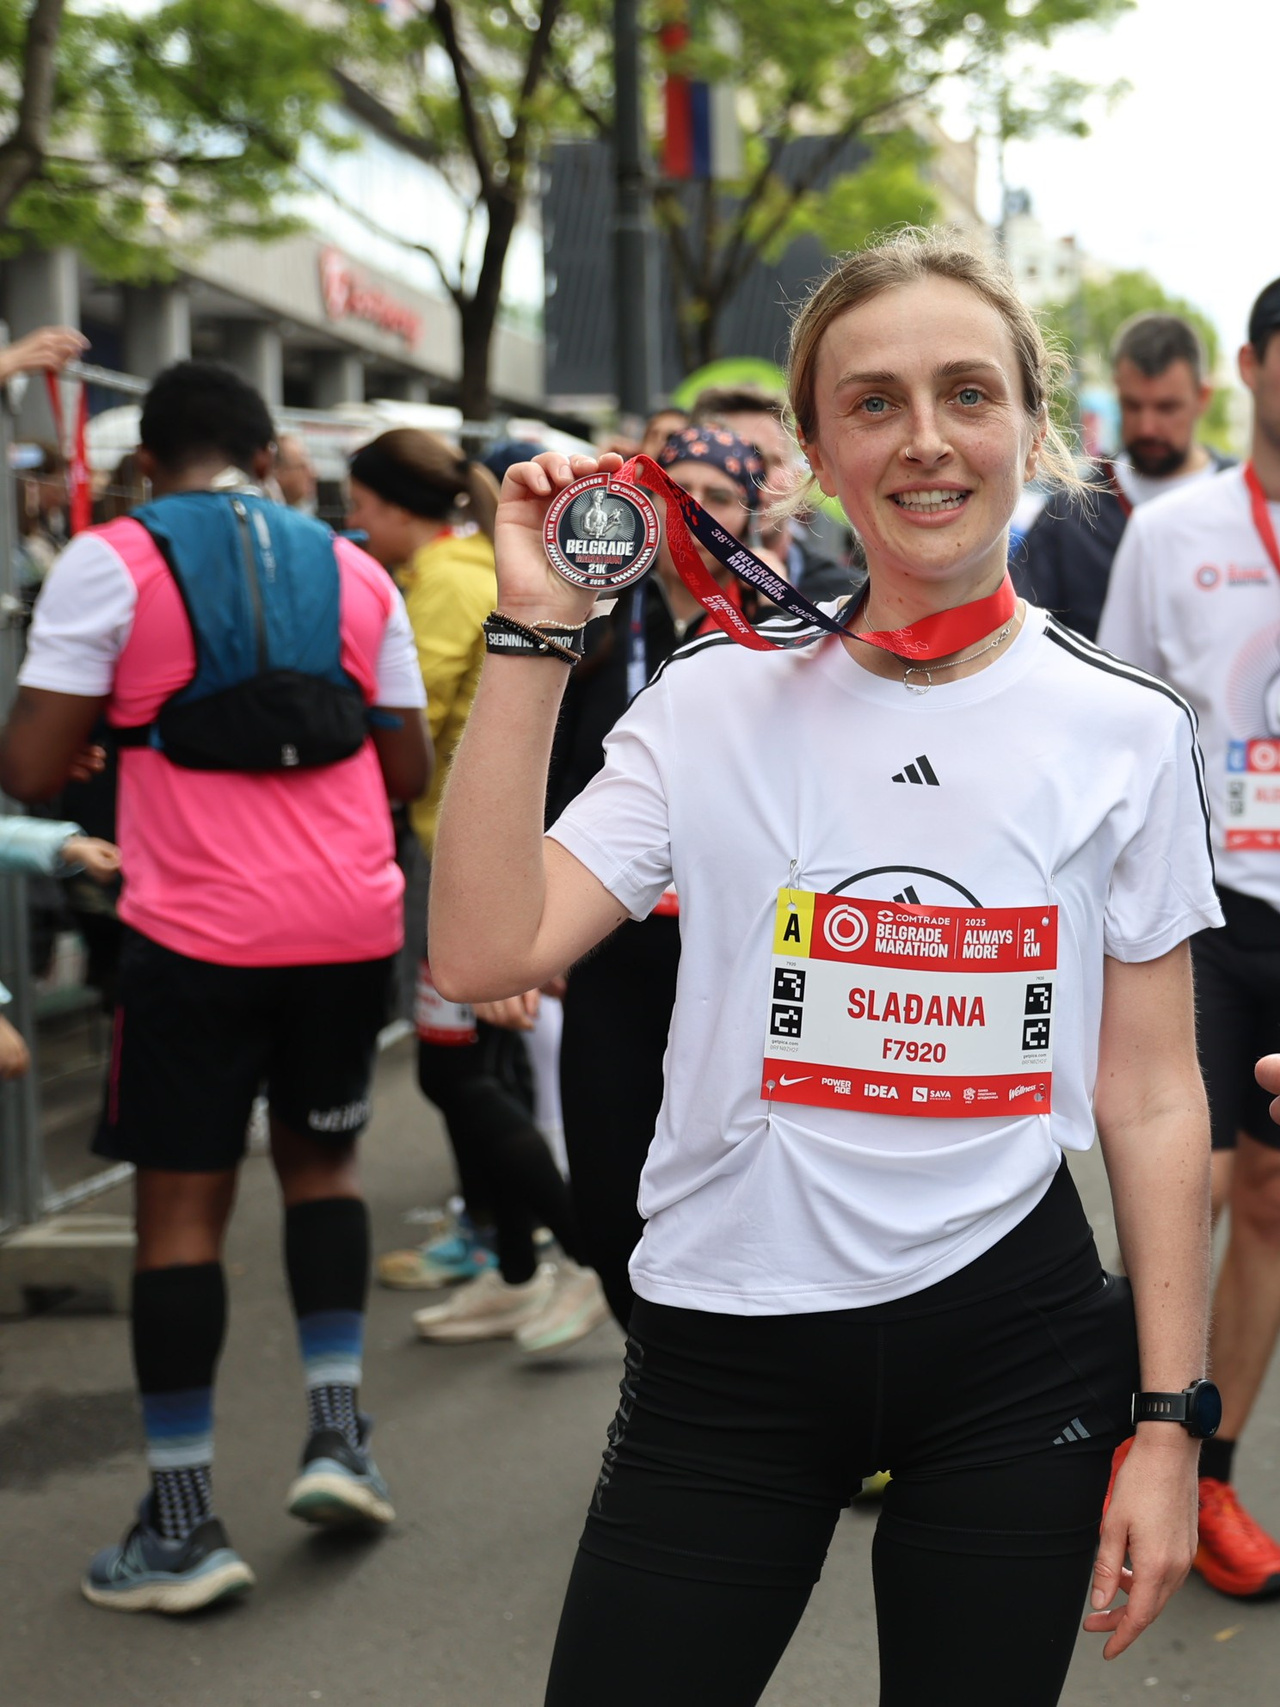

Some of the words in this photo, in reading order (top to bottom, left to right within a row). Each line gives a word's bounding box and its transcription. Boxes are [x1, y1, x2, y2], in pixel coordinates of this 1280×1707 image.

[711, 528, 736, 548] 38TH
[566, 539, 634, 556] BELGRADE
[588, 563, 607, 574] 21K
[734, 550, 788, 594] BELGRADE
[727, 556, 785, 601] MARATHON
[702, 596, 723, 612] 21K
[712, 594, 749, 634] FINISHER
[788, 604, 819, 623] 2025
[783, 913, 801, 942] A
[896, 914, 950, 926] COMTRADE
[965, 918, 986, 926] 2025
[876, 923, 943, 943] BELGRADE
[964, 929, 1013, 944] ALWAYS
[1023, 928, 1035, 943] 21
[875, 938, 949, 958] MARATHON
[962, 945, 999, 959] MORE
[1023, 942, 1040, 957] KM
[847, 987, 986, 1027] SLAĐANA
[882, 1038, 947, 1063] F7920
[821, 1077, 851, 1088] POWER
[834, 1086, 851, 1095] ADE
[930, 1090, 951, 1098] SAVA
[1008, 1084, 1037, 1101] Wellness
